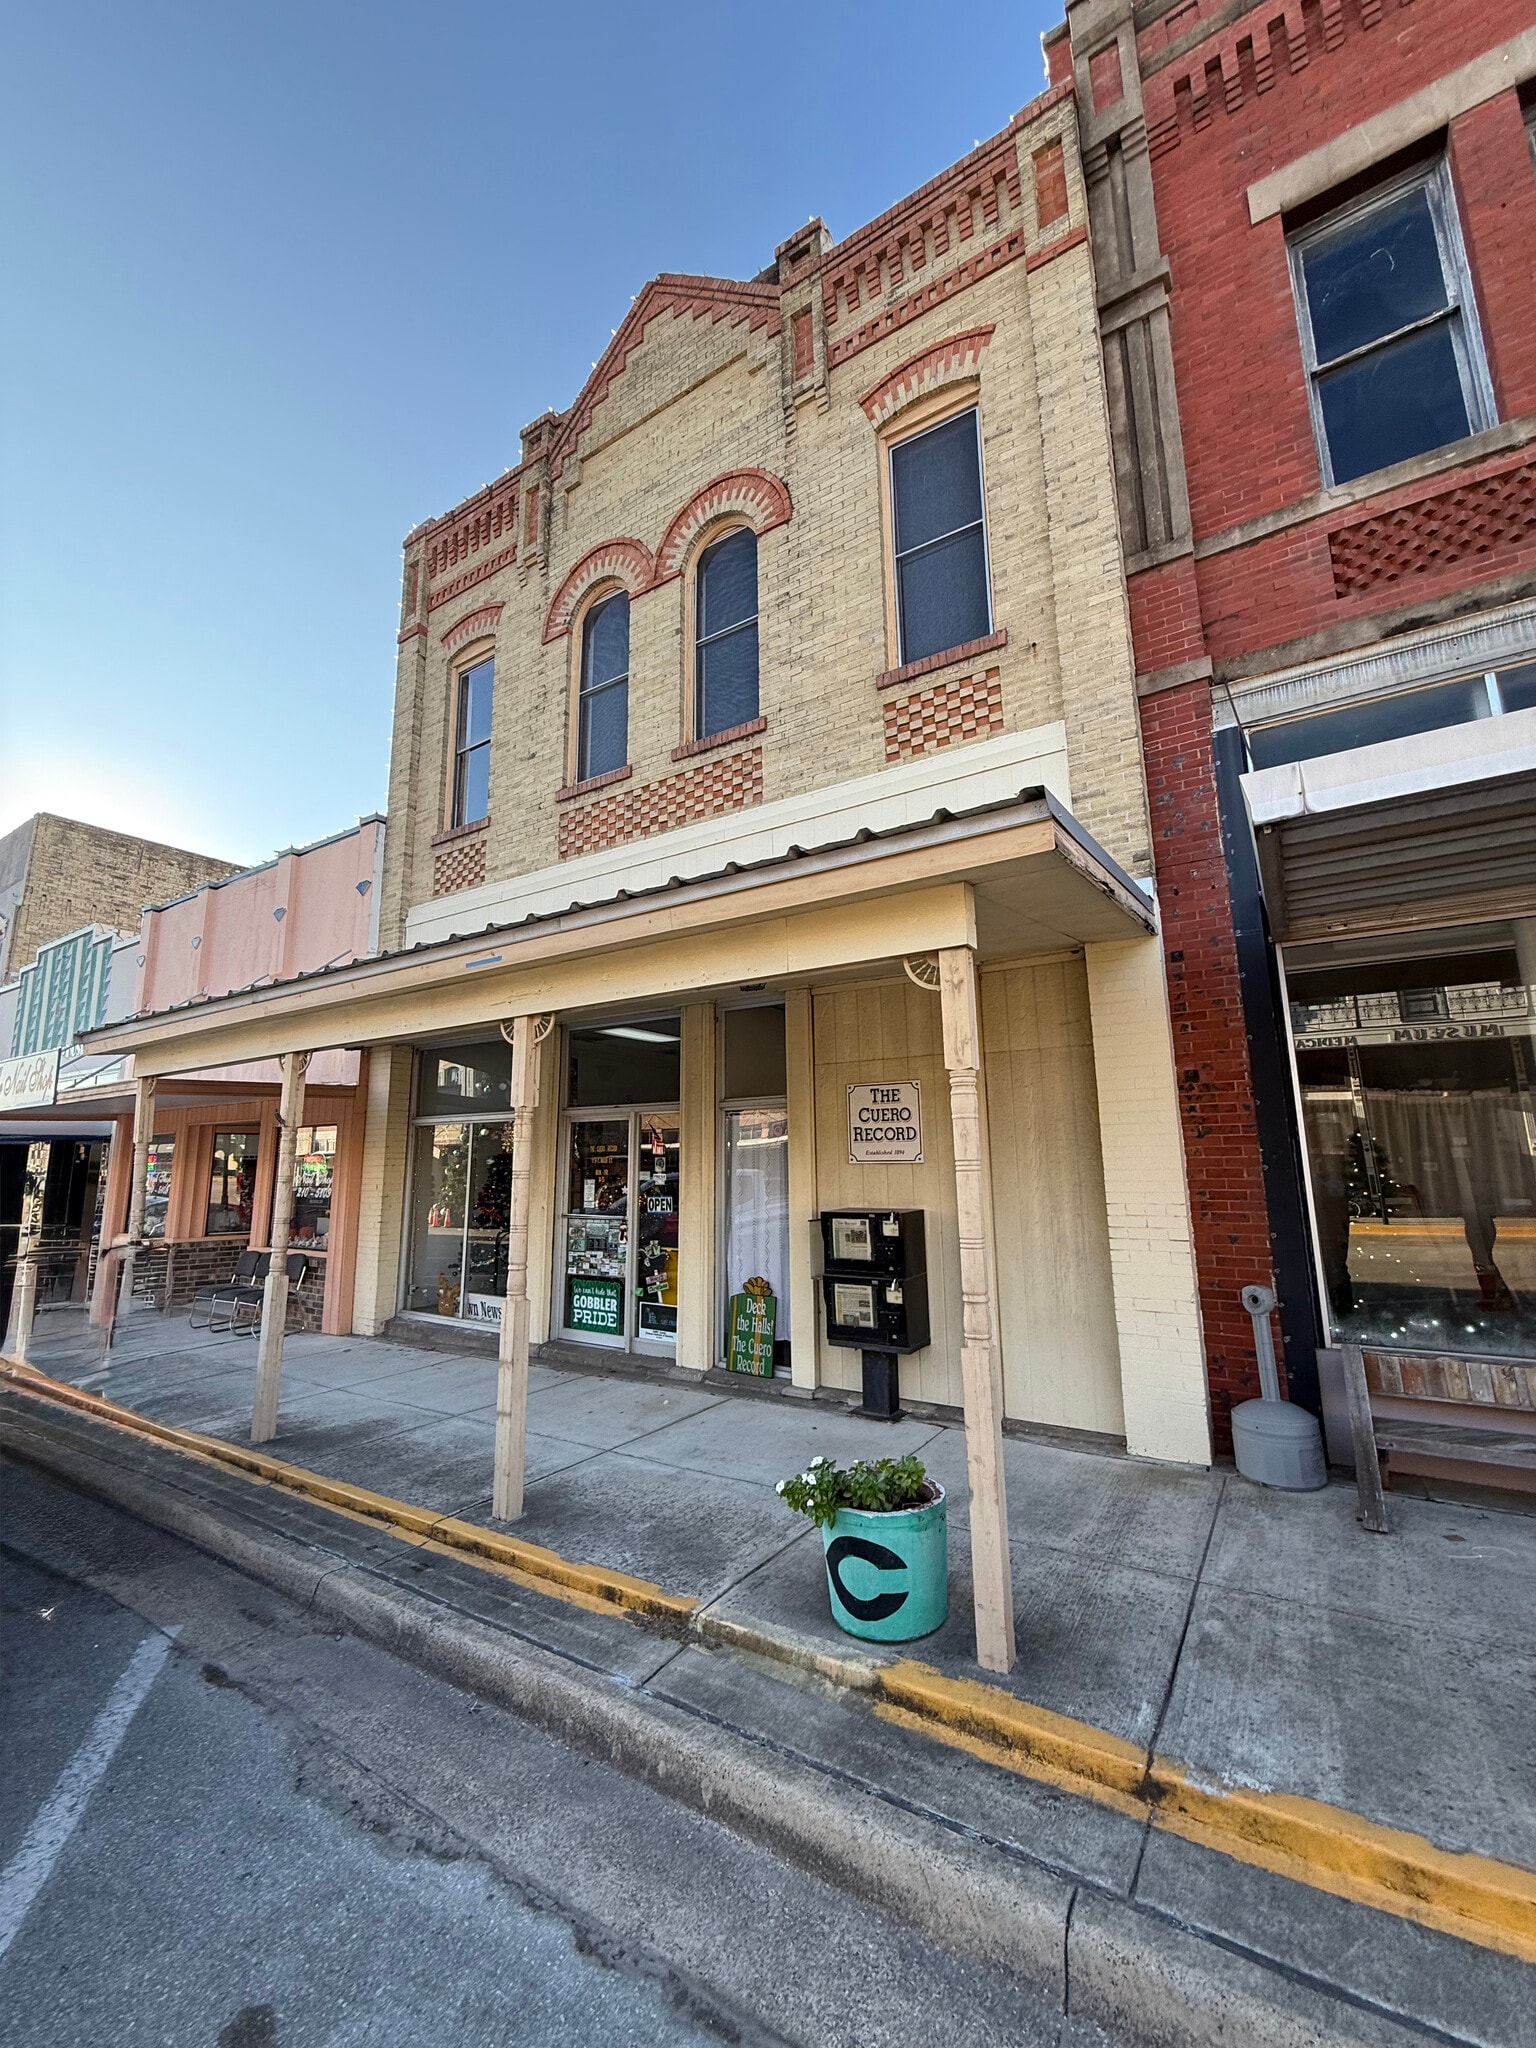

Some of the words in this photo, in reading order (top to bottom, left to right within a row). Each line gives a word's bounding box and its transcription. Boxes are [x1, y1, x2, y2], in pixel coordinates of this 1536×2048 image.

[4, 1062, 32, 1097] Nail
[29, 1057, 54, 1101] Shop
[870, 1088, 901, 1104] THE
[858, 1107, 912, 1123] CUERO
[853, 1127, 917, 1142] RECORD
[648, 1198, 672, 1212] OPEN
[573, 1294, 618, 1312] GOBBLER
[746, 1298, 767, 1316] Deck
[573, 1308, 618, 1328] PRIDE
[737, 1314, 750, 1332] the
[751, 1317, 774, 1336] Halls!
[732, 1335, 747, 1353] The
[748, 1338, 772, 1357] Cuero
[736, 1354, 765, 1376] Record
[826, 1535, 910, 1622] C
